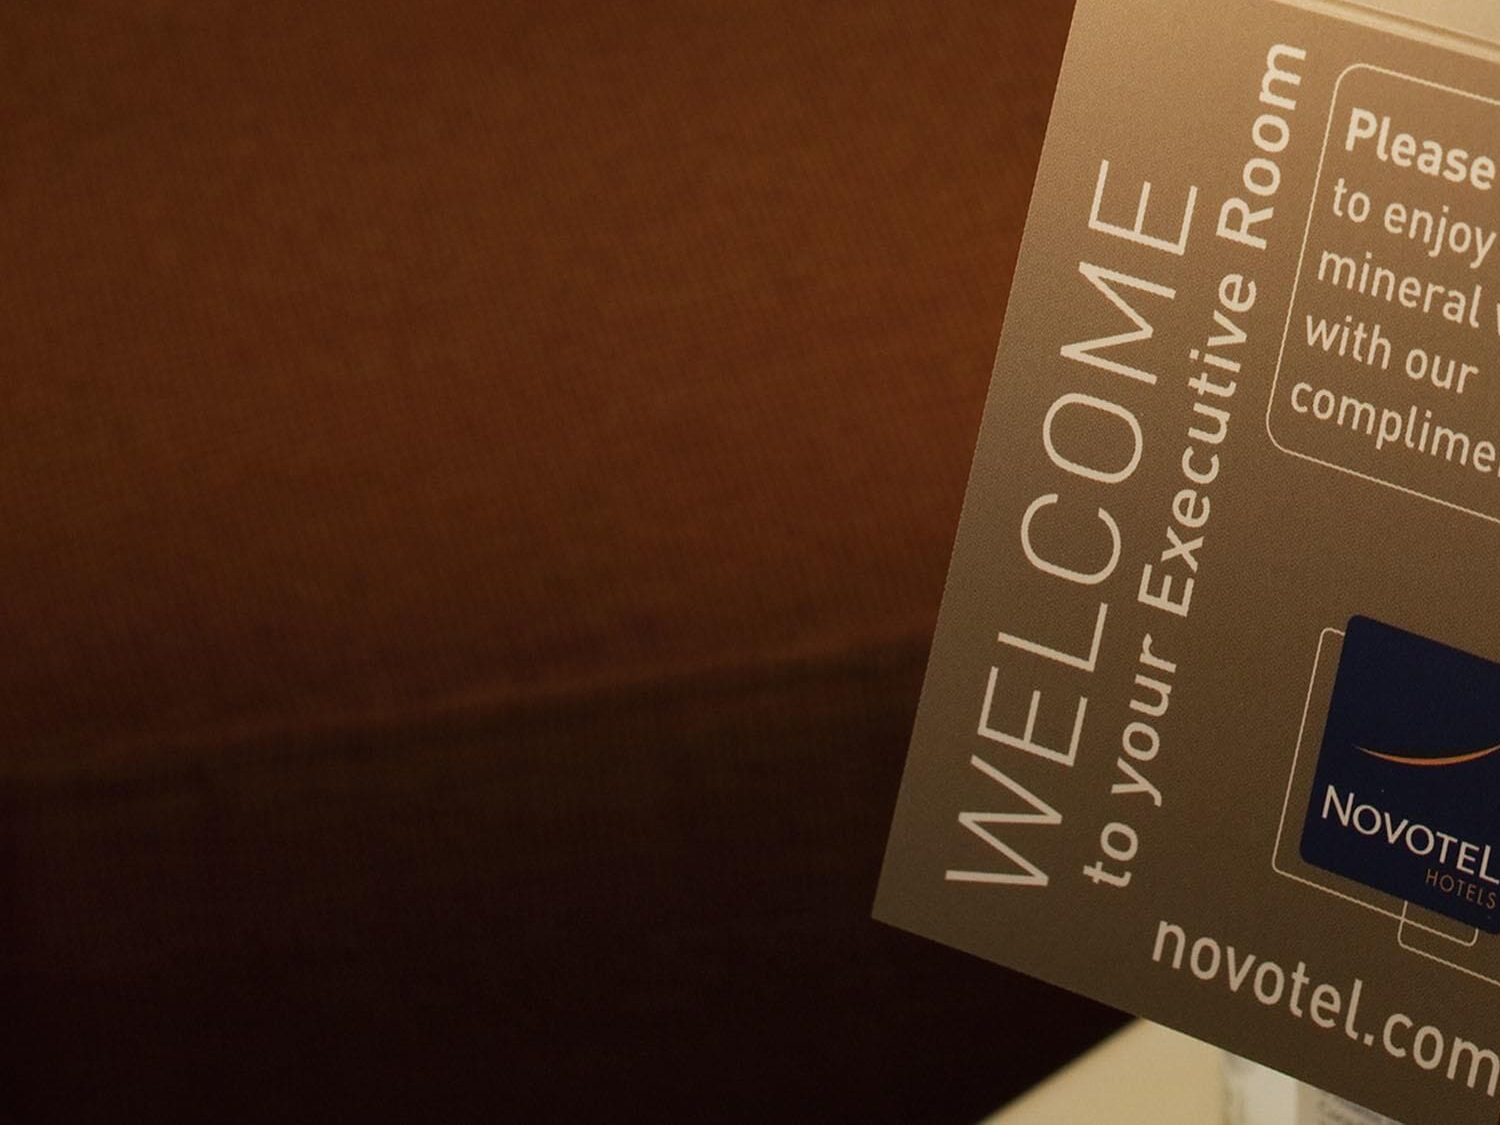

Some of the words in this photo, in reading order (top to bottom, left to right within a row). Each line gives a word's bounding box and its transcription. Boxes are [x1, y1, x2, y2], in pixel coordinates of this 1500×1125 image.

[1215, 43, 1307, 250] Room
[1345, 106, 1496, 191] Please
[1333, 177, 1371, 224] to
[1383, 202, 1497, 270] enjoy
[1316, 250, 1482, 329] mineral
[1304, 314, 1392, 371] with
[1405, 348, 1479, 395] our
[1137, 272, 1258, 617] Executive
[944, 158, 1199, 888] WELCOME
[1111, 633, 1178, 806] your
[1083, 822, 1140, 888] to
[1320, 784, 1500, 886] NOVOTEL
[1425, 867, 1498, 911] HOTELS
